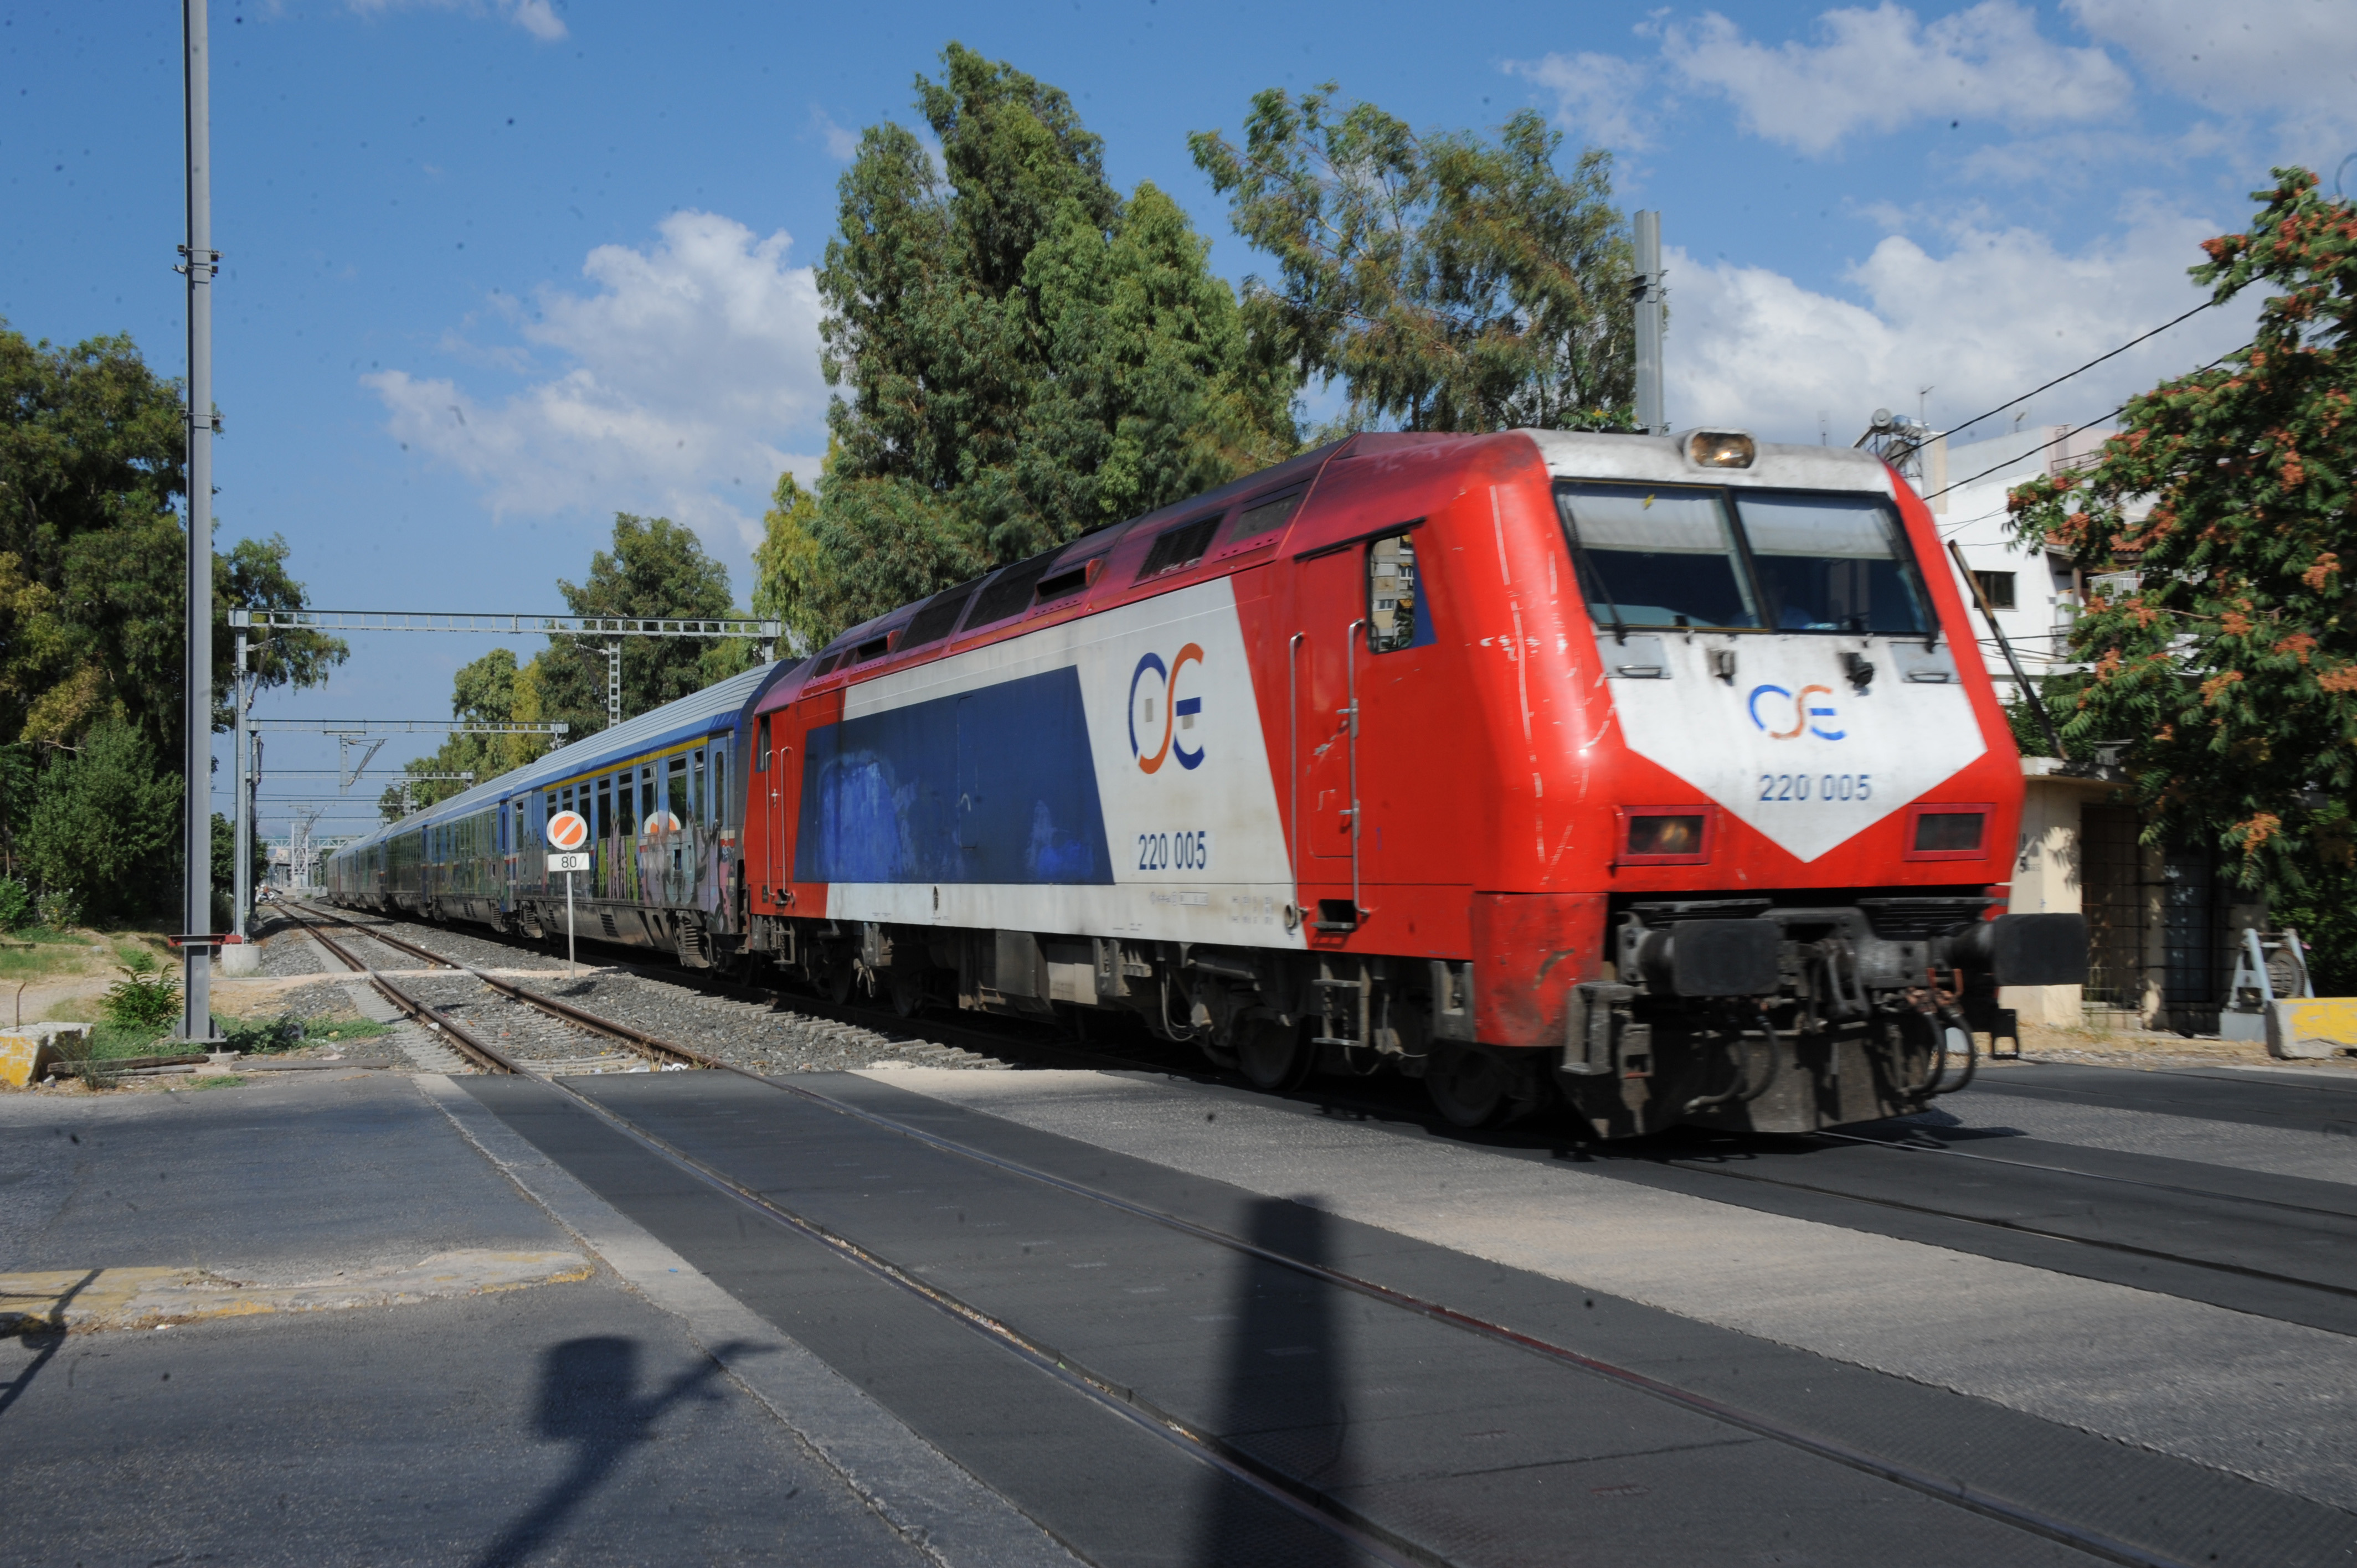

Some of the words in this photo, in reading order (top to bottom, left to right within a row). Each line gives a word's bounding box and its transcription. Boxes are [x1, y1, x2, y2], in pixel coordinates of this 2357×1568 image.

[1759, 775, 1811, 801] 220
[1820, 775, 1872, 801] 005
[562, 856, 577, 868] 80
[1138, 833, 1167, 870] 220
[1175, 831, 1206, 870] 005
